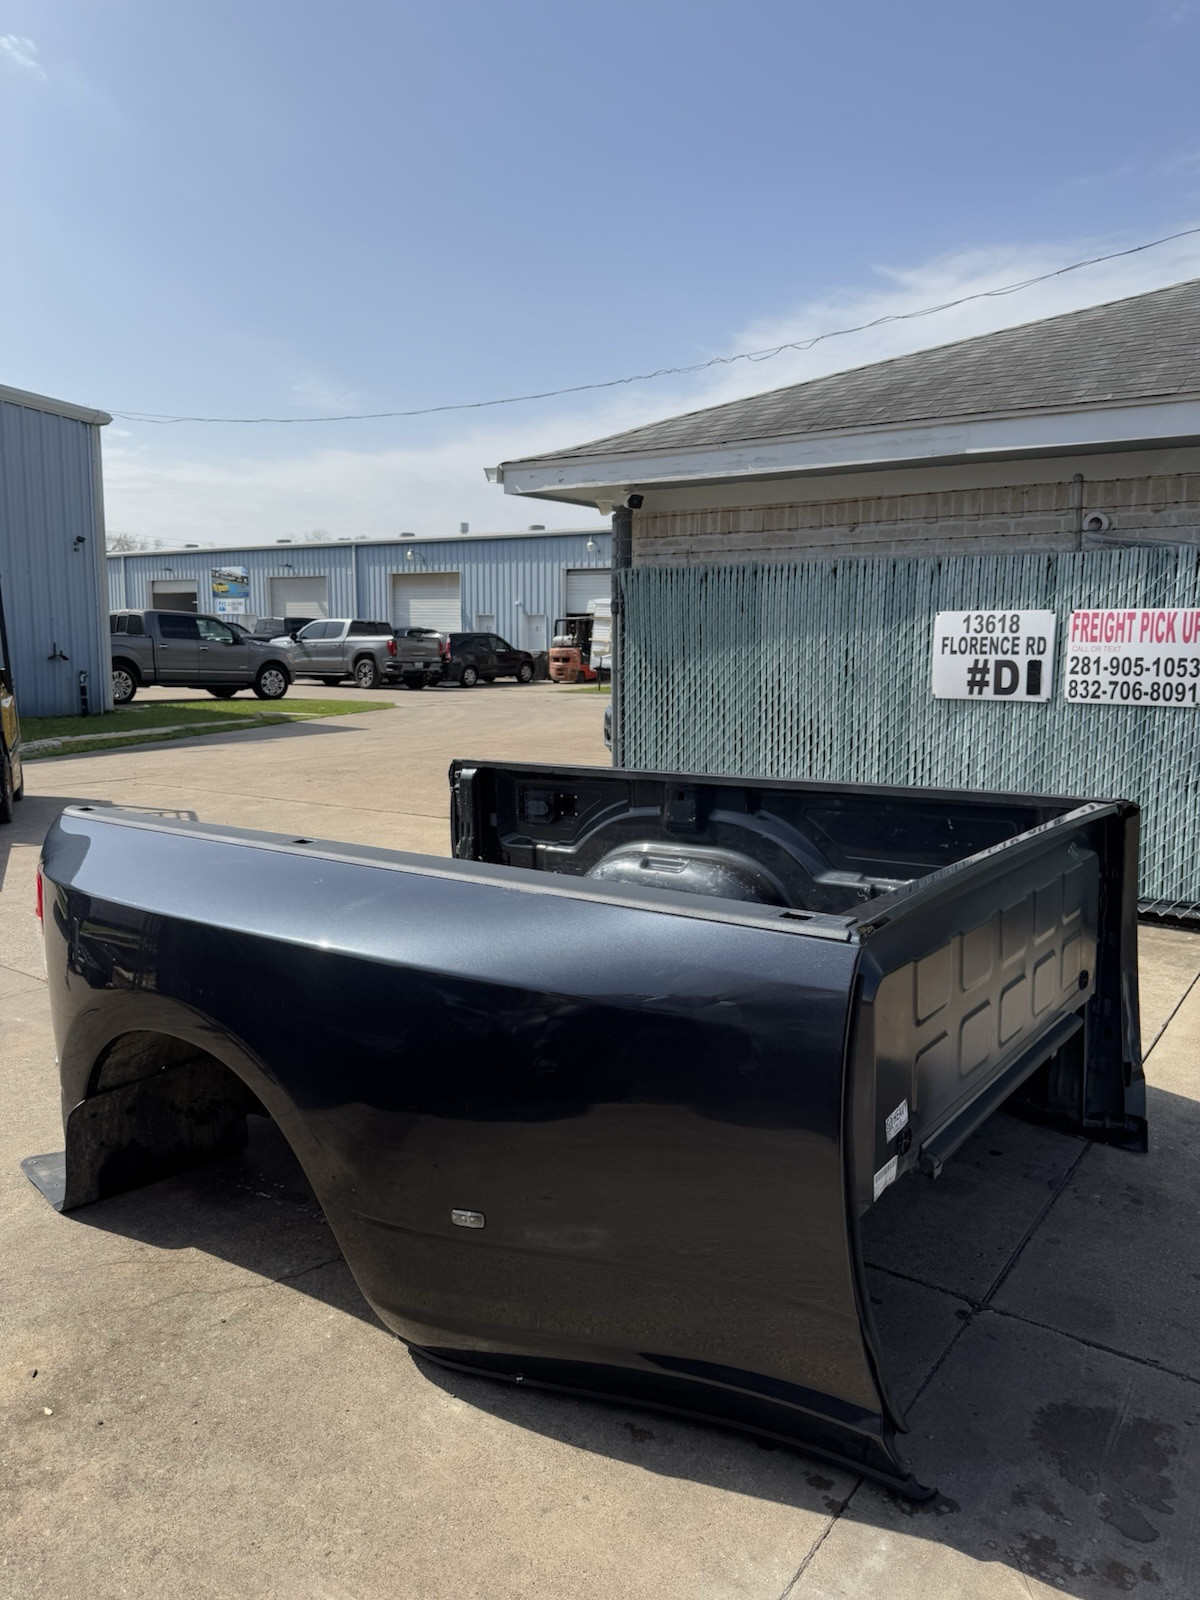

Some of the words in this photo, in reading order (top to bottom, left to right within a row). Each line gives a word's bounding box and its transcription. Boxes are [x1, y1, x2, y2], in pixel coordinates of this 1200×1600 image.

[963, 614, 1020, 634] 13618
[1071, 611, 1137, 643] FREIGHT
[1139, 611, 1178, 643] PICK
[941, 636, 1020, 656] FLORENCE
[1026, 636, 1047, 656] RD
[1072, 645, 1089, 653] CALL
[1091, 645, 1102, 653] OR
[1103, 645, 1122, 653] TEXT
[1069, 656, 1200, 678] 281-905-1053
[1068, 680, 1197, 703] 832-706-8091
